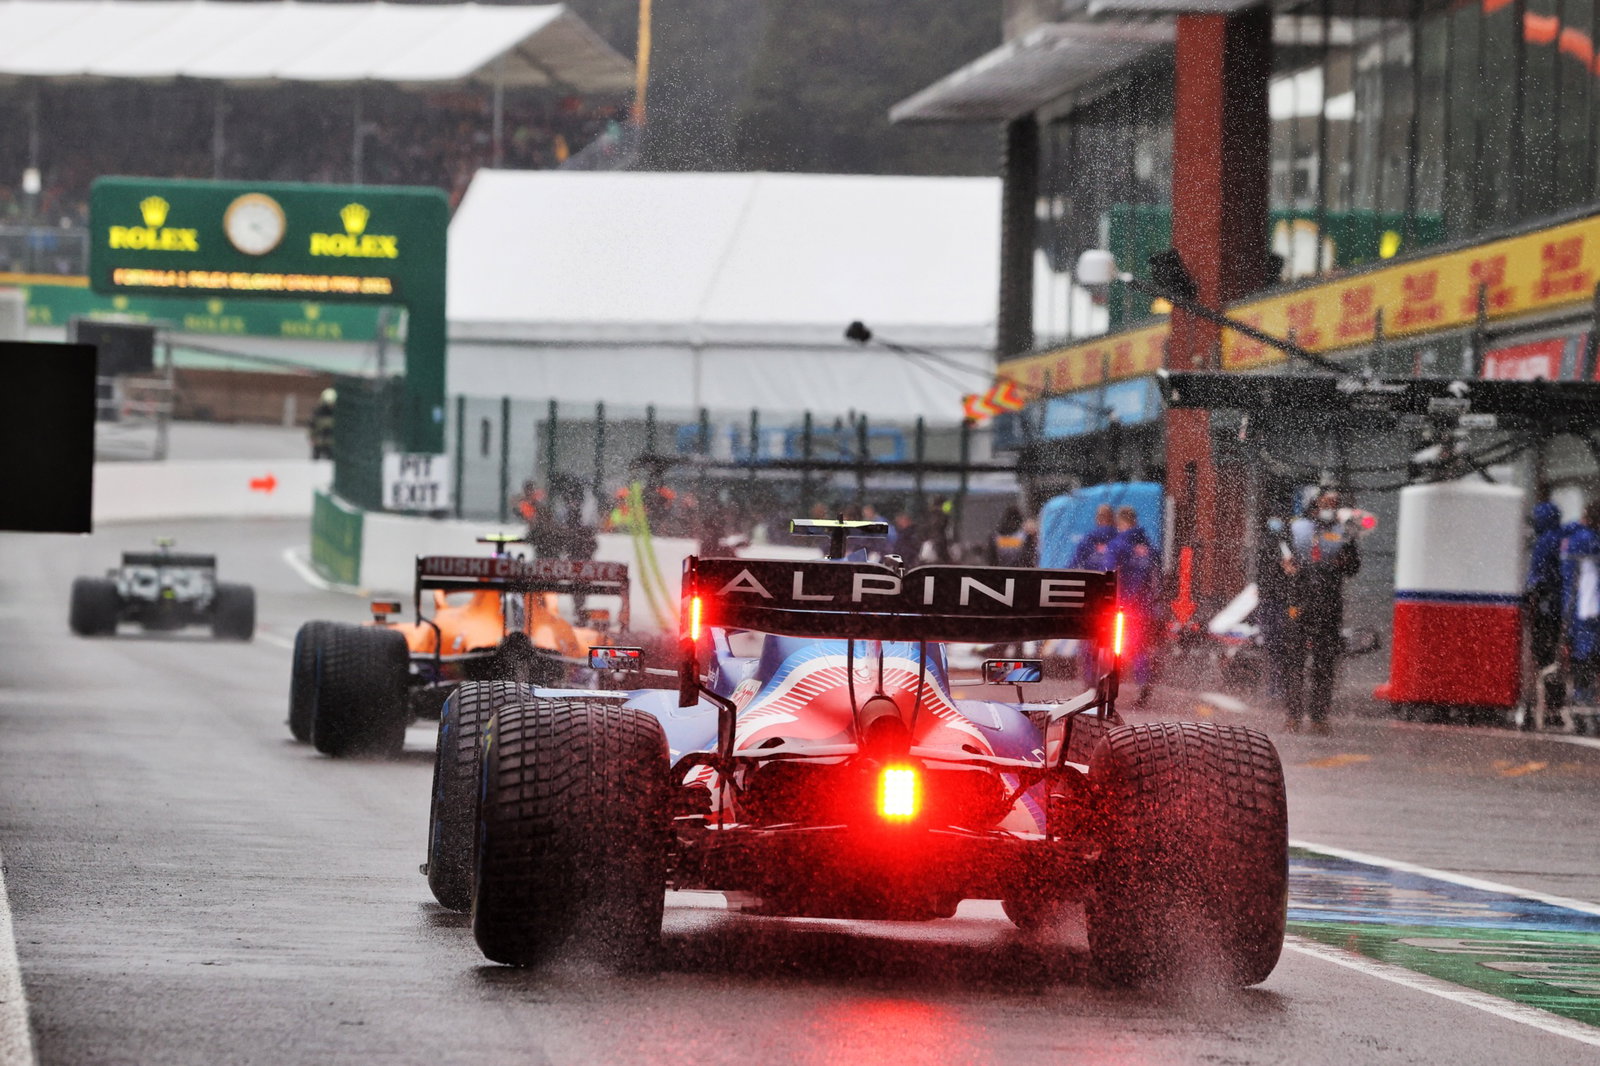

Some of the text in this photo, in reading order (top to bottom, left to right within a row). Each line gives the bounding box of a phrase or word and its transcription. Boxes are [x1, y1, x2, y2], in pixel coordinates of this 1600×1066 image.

[109, 226, 198, 251] ROLEX
[310, 233, 398, 258] ROLEX
[401, 455, 431, 476] PIT
[393, 483, 438, 503] EXIT
[426, 558, 489, 574] HUSKI
[716, 568, 1086, 608] ALPINE
